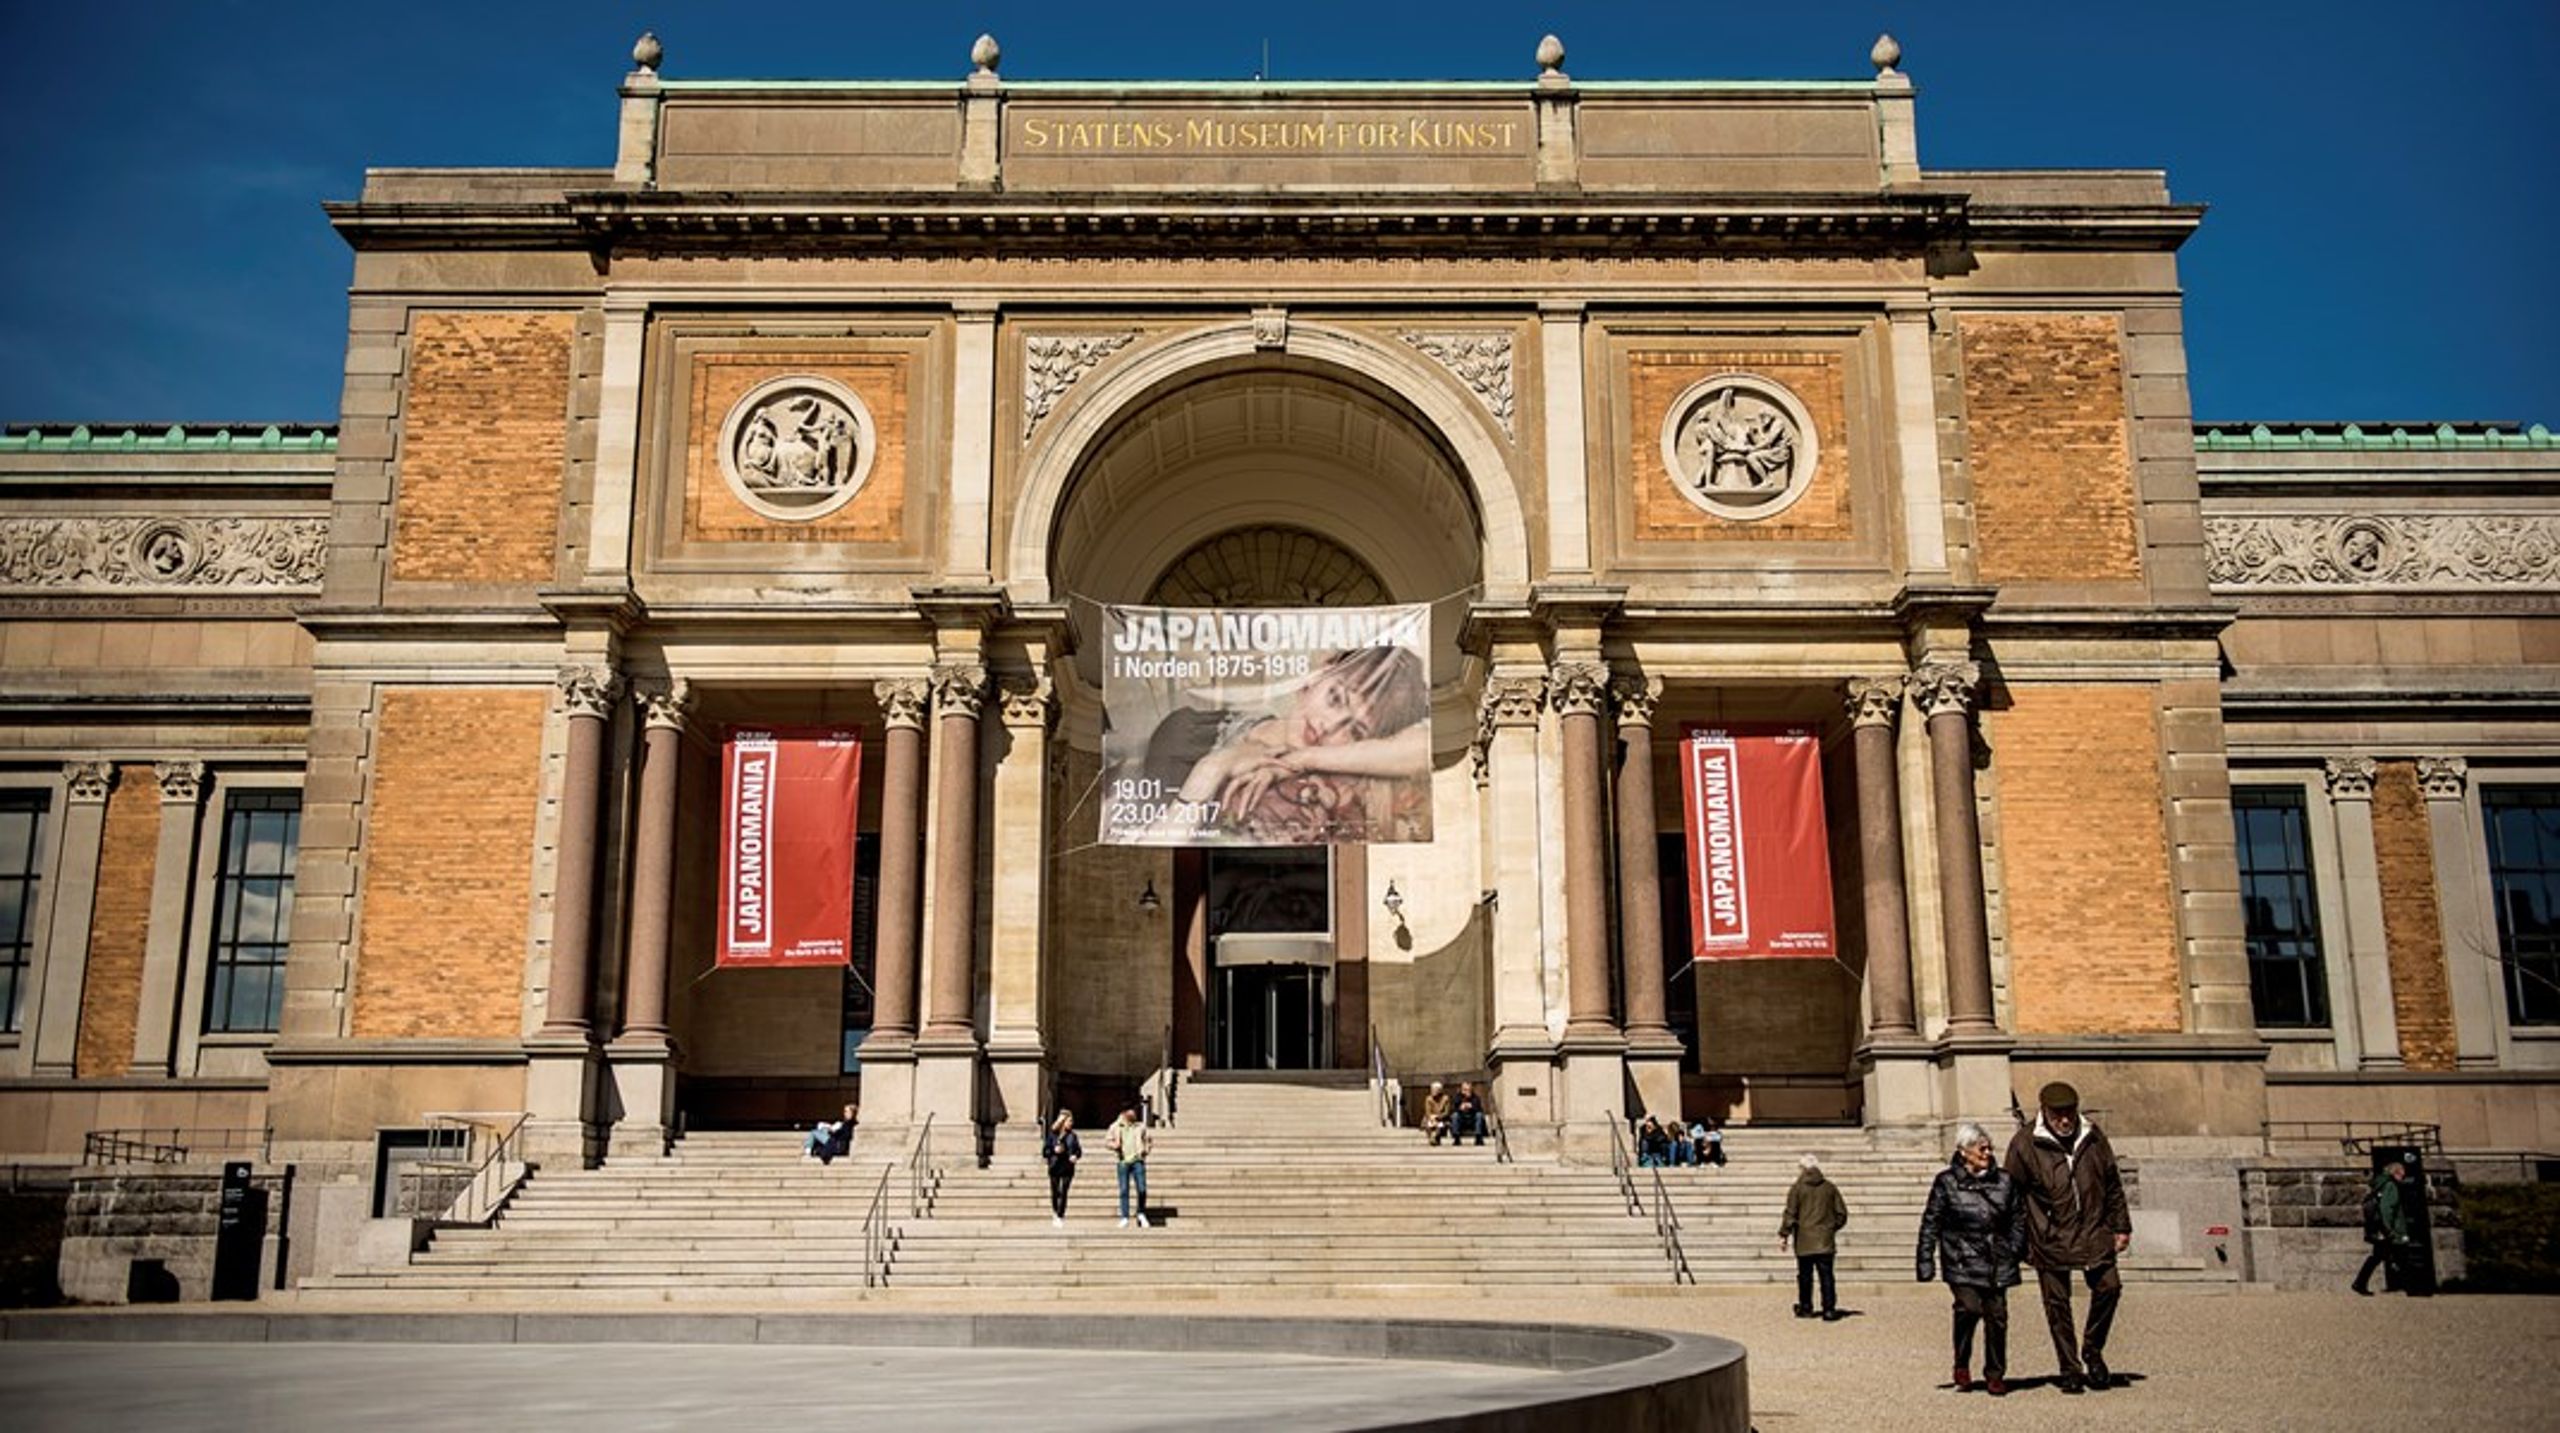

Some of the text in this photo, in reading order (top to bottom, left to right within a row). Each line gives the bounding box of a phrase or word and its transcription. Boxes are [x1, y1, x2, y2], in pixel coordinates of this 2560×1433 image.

[1410, 118, 1517, 148] KUNST
[1113, 654, 1311, 678] i Norden 1875-1918
[1111, 779, 1162, 800] 19.01
[1111, 800, 1221, 824] 23.04 2017
[740, 759, 766, 933] JAPANOMANIA
[1705, 756, 1737, 926] JAPANOMANIA
